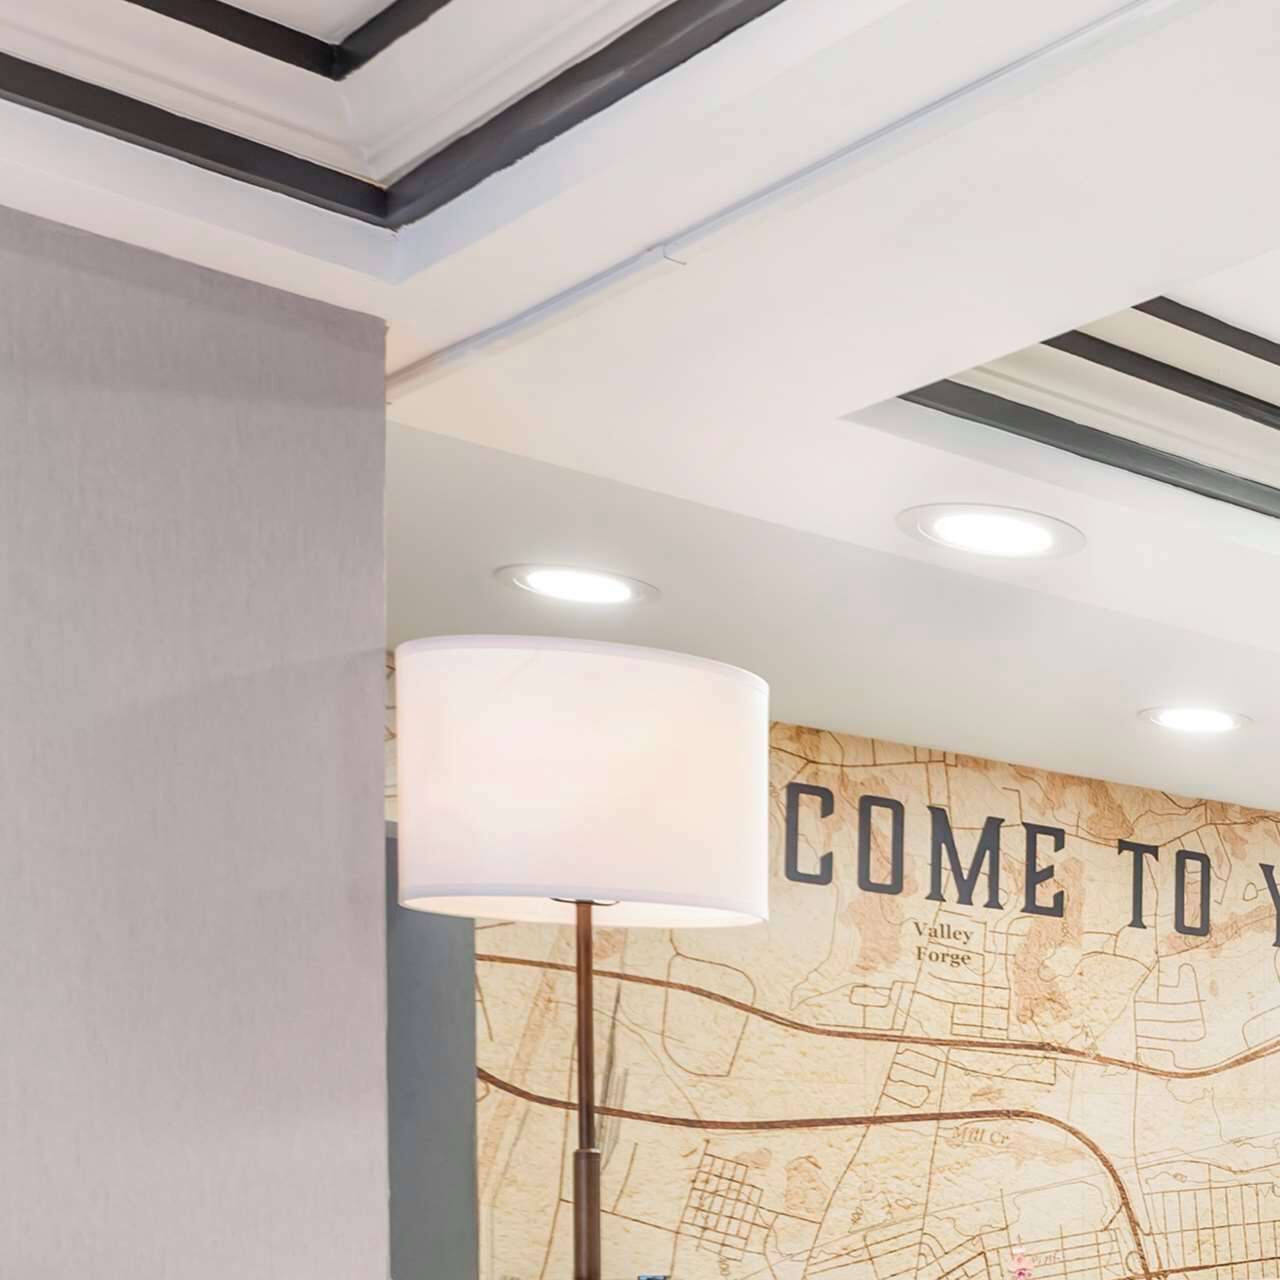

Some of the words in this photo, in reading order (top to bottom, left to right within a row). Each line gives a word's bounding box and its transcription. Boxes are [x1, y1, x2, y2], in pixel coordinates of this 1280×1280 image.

[785, 781, 1065, 918] COME
[1118, 838, 1211, 937] TO
[913, 921, 975, 945] Valley
[915, 945, 972, 968] Forge
